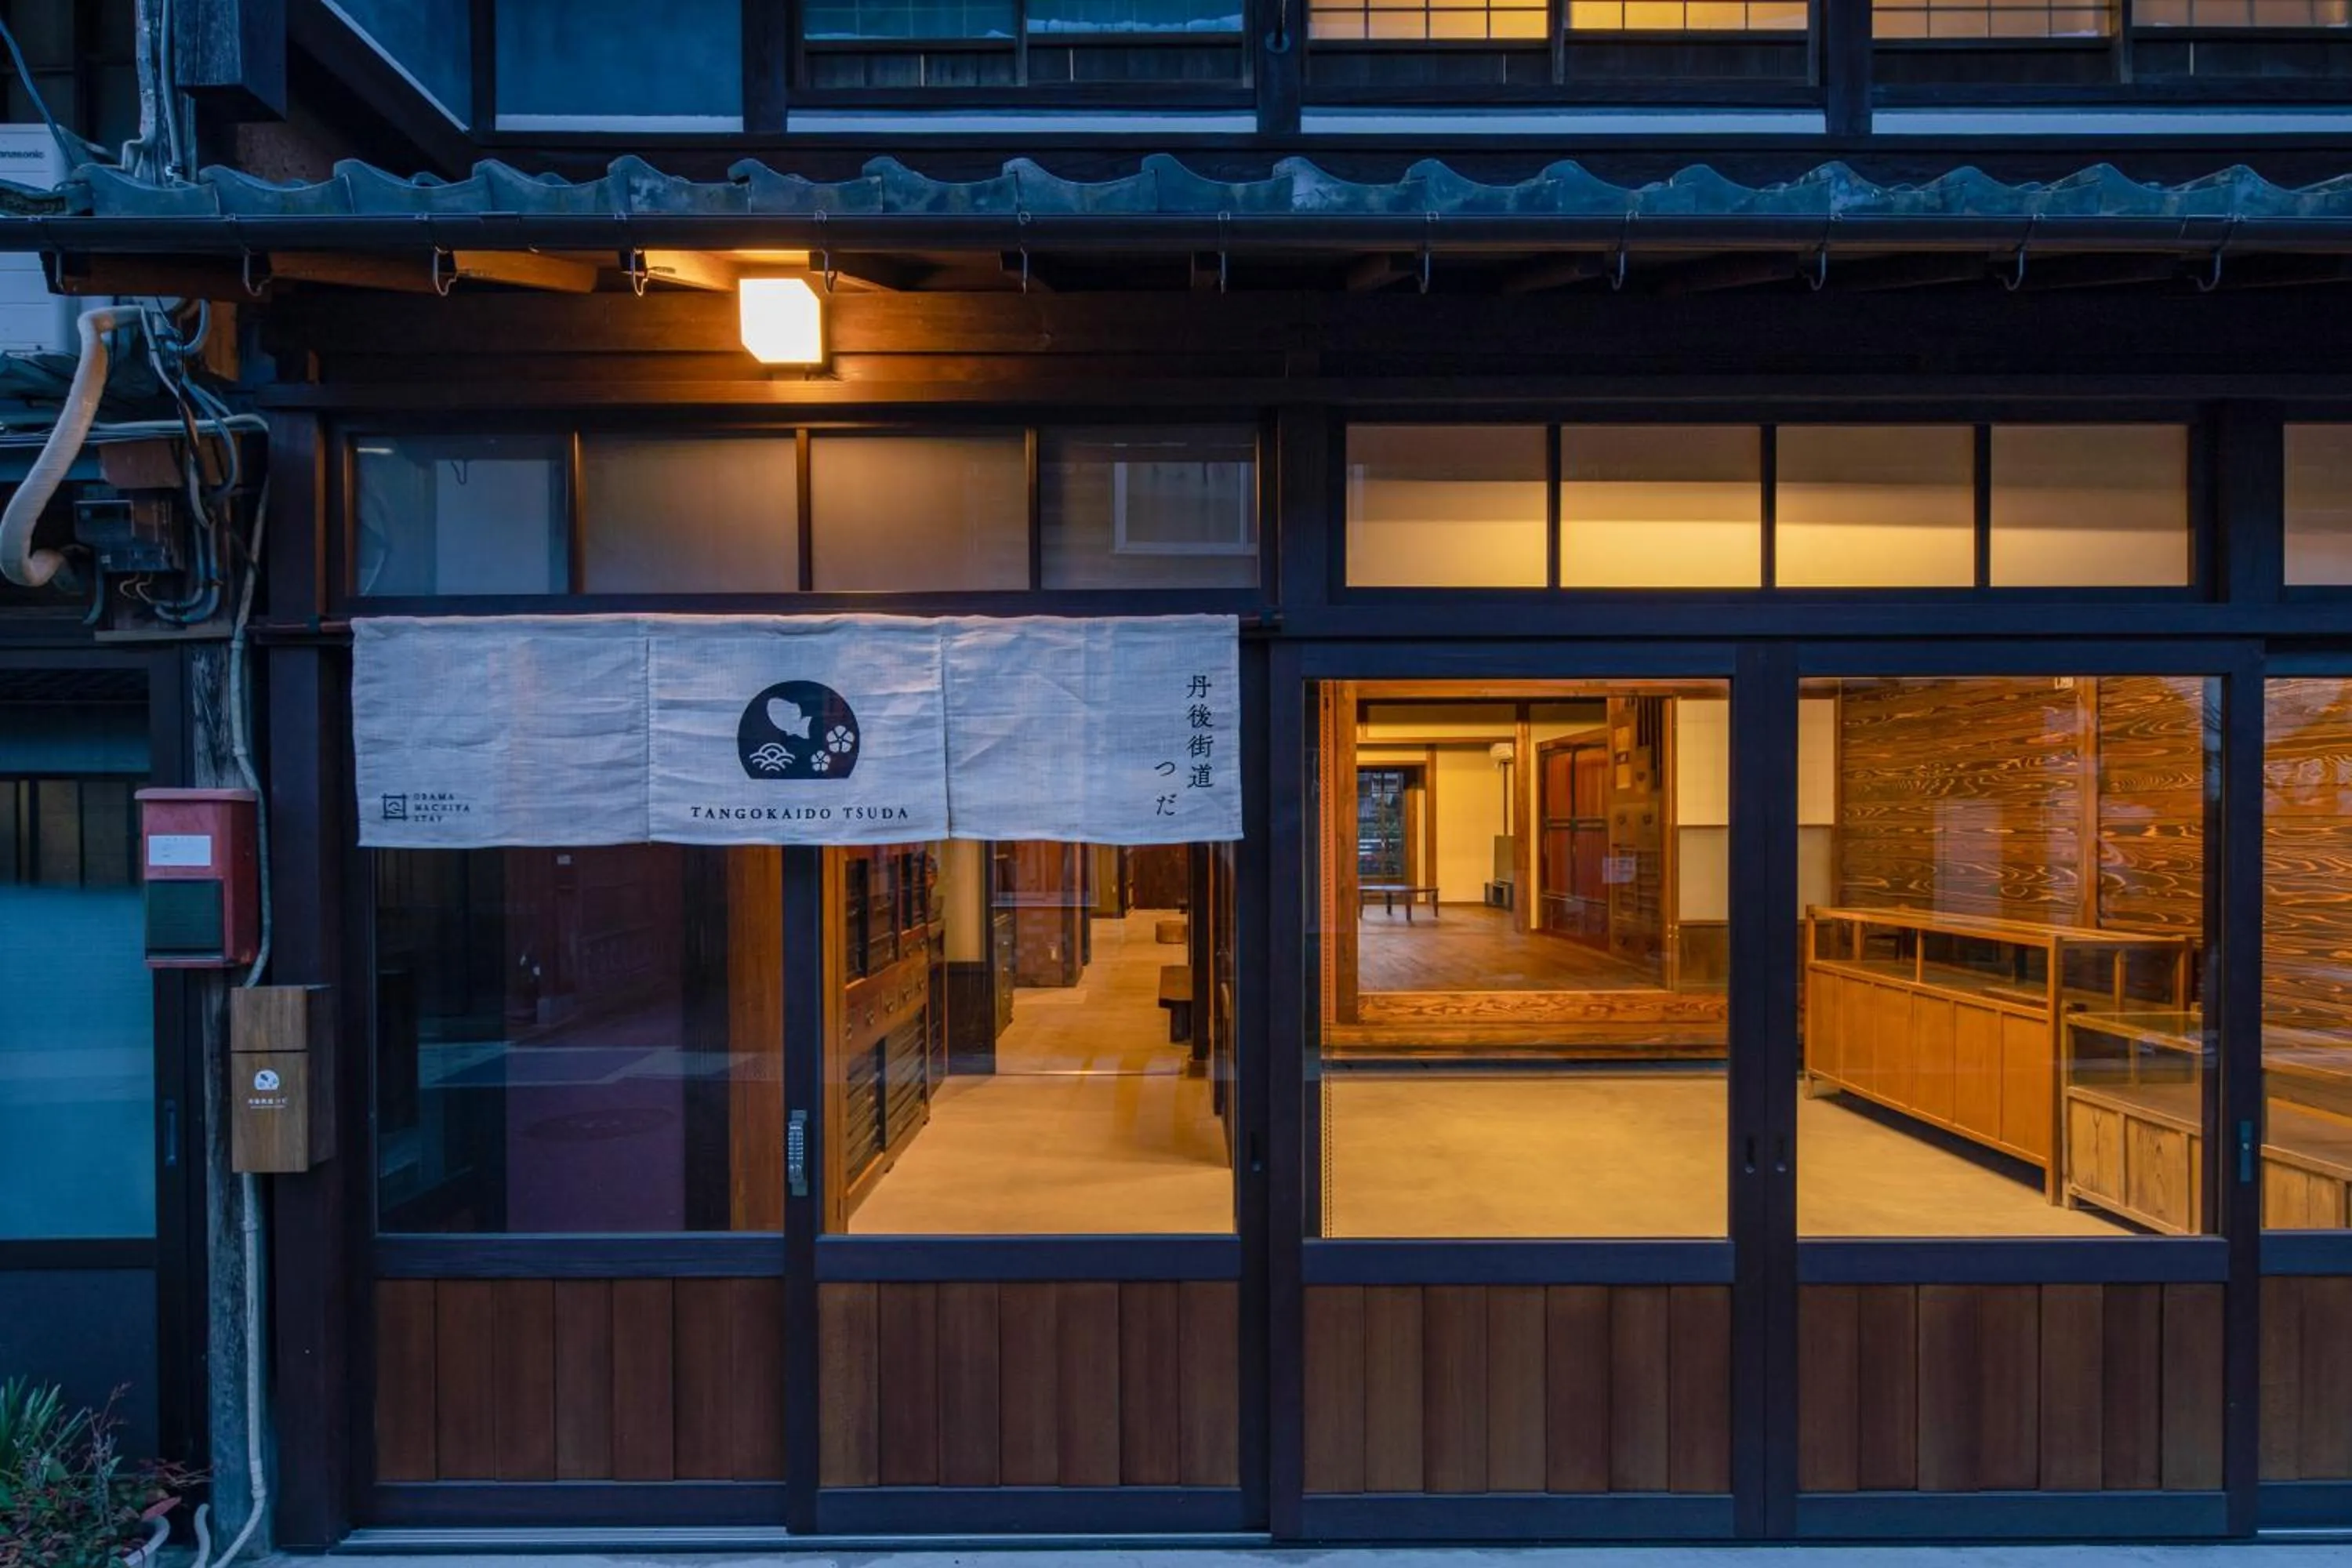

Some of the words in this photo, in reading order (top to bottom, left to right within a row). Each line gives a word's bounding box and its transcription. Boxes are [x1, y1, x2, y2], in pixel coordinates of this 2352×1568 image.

[0, 149, 45, 158] anasonic
[1186, 674, 1214, 789] 丹後街道
[1154, 761, 1177, 816] つだ
[690, 806, 831, 819] TANGOKAIDO
[843, 806, 909, 820] TSUDA
